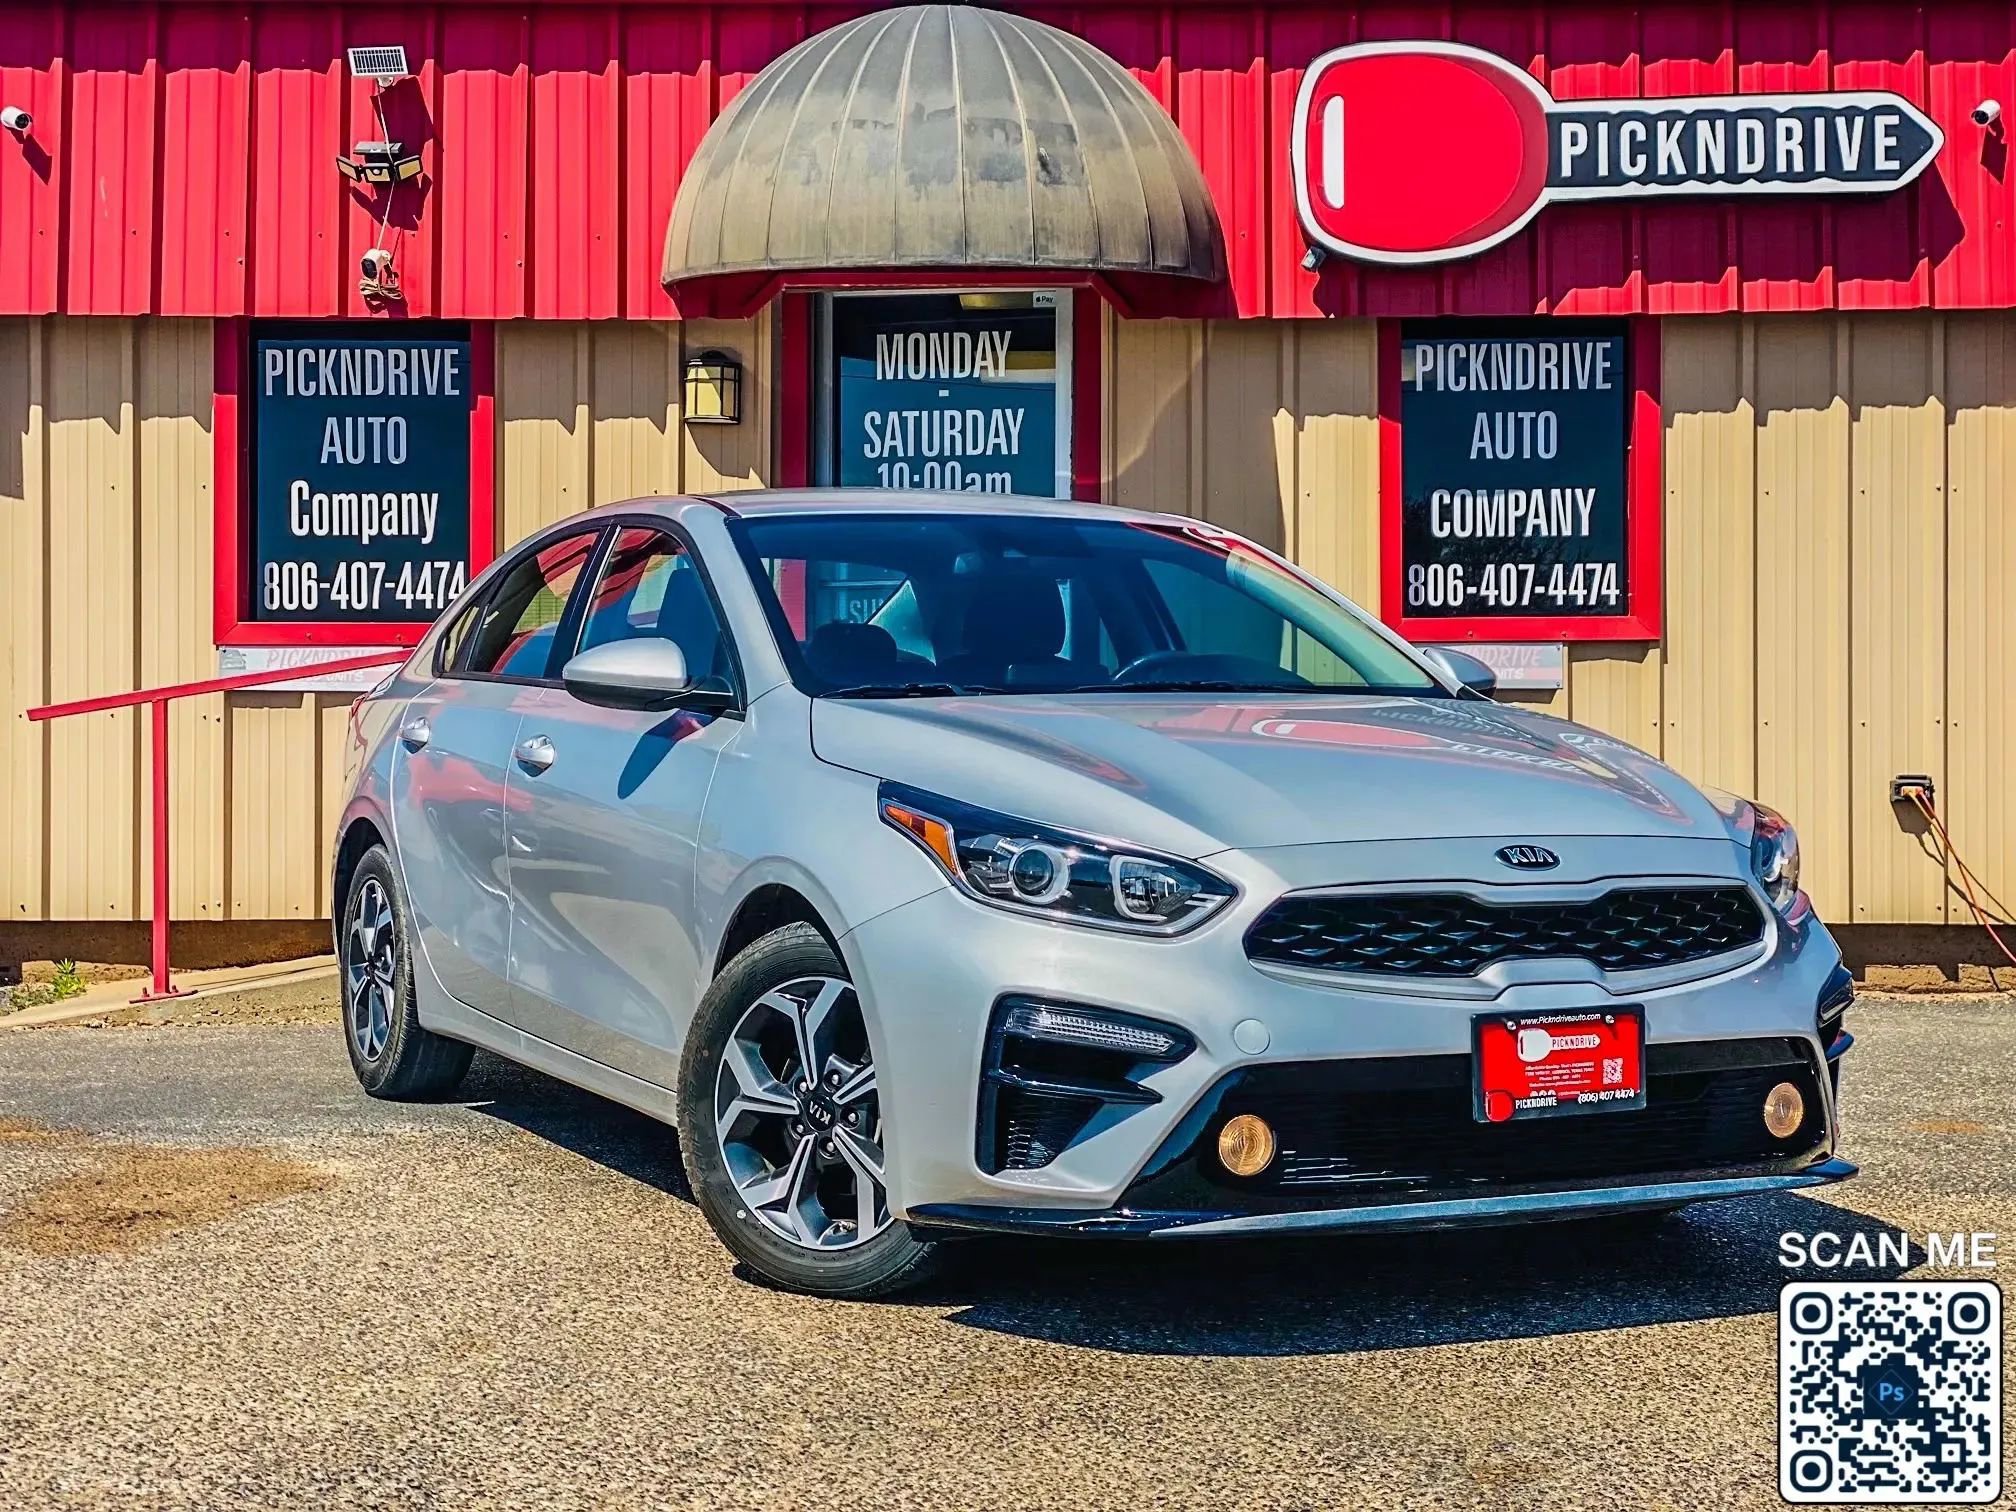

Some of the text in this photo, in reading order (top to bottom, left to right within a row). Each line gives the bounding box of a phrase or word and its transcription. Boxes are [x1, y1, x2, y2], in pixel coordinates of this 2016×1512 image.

[1560, 114, 1901, 178] PICKNDRIVE
[265, 348, 460, 397] PICKNDRIVE
[876, 330, 1012, 381] MONDAY
[1415, 342, 1612, 392] PICKNDRIVE
[320, 416, 407, 465] AUTO
[863, 408, 1025, 458] SATURDAY
[1469, 410, 1558, 460] AUTO
[290, 479, 439, 545] Company
[1430, 488, 1596, 538] COMPANY
[263, 560, 466, 611] 806-407-4474
[1408, 563, 1621, 607] 806-407-4474
[1503, 847, 1555, 864] KIA
[1552, 1036, 1597, 1049] PICKNDRIVE
[1515, 1096, 1558, 1110] PICKNDRIVE
[1599, 1090, 1615, 1101] 407
